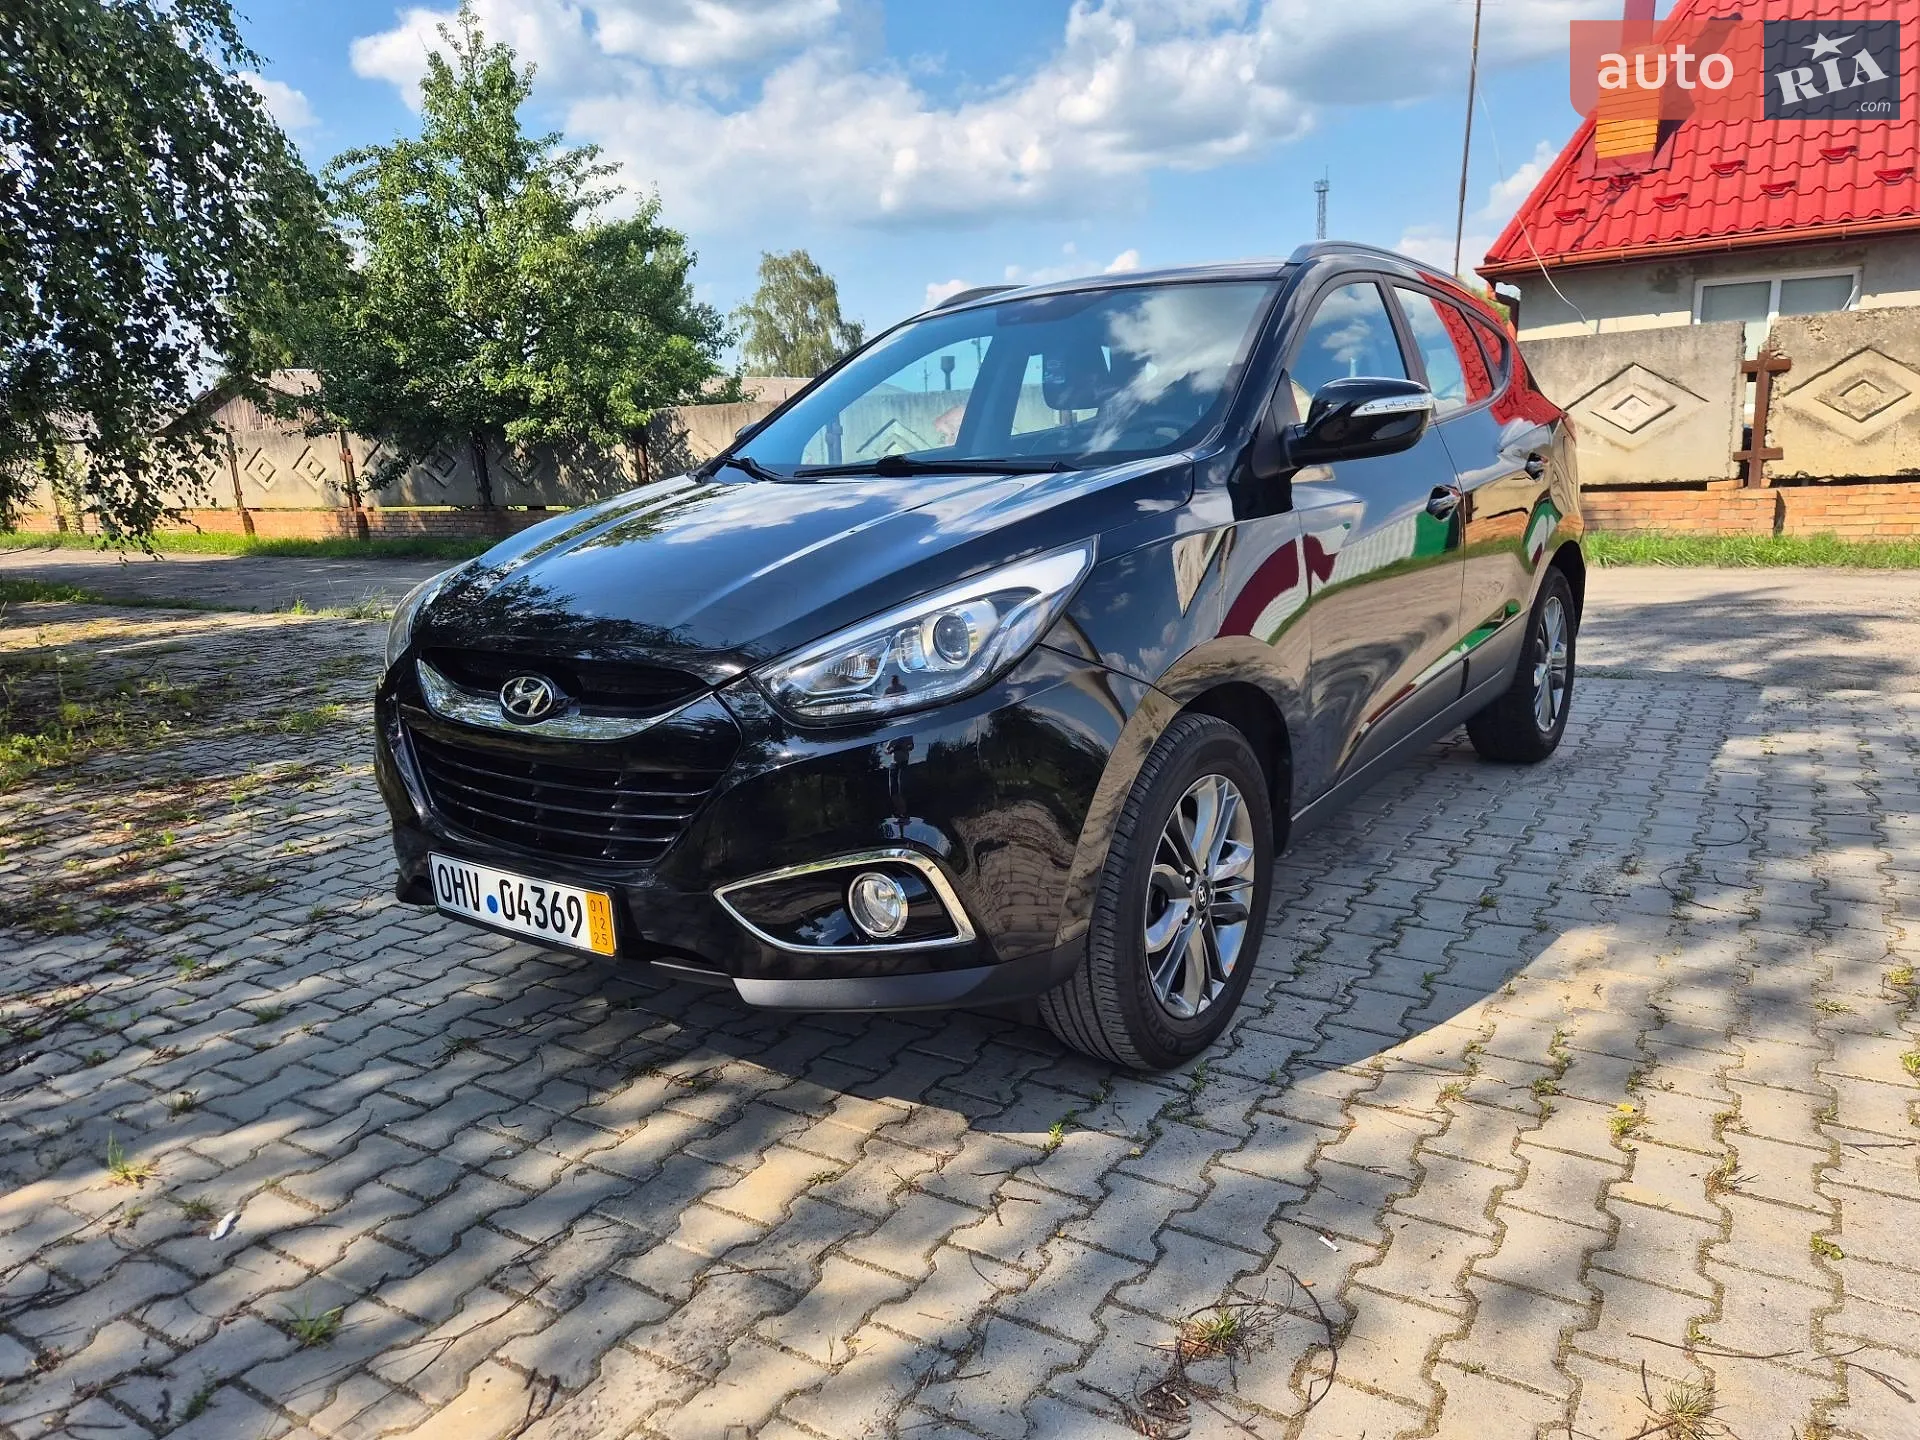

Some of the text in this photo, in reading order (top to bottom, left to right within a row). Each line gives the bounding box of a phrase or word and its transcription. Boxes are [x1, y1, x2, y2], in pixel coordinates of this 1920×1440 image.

[438, 863, 583, 939] OHV 04369
[590, 899, 604, 914] 01
[593, 916, 606, 930] 12
[594, 932, 608, 946] 25
